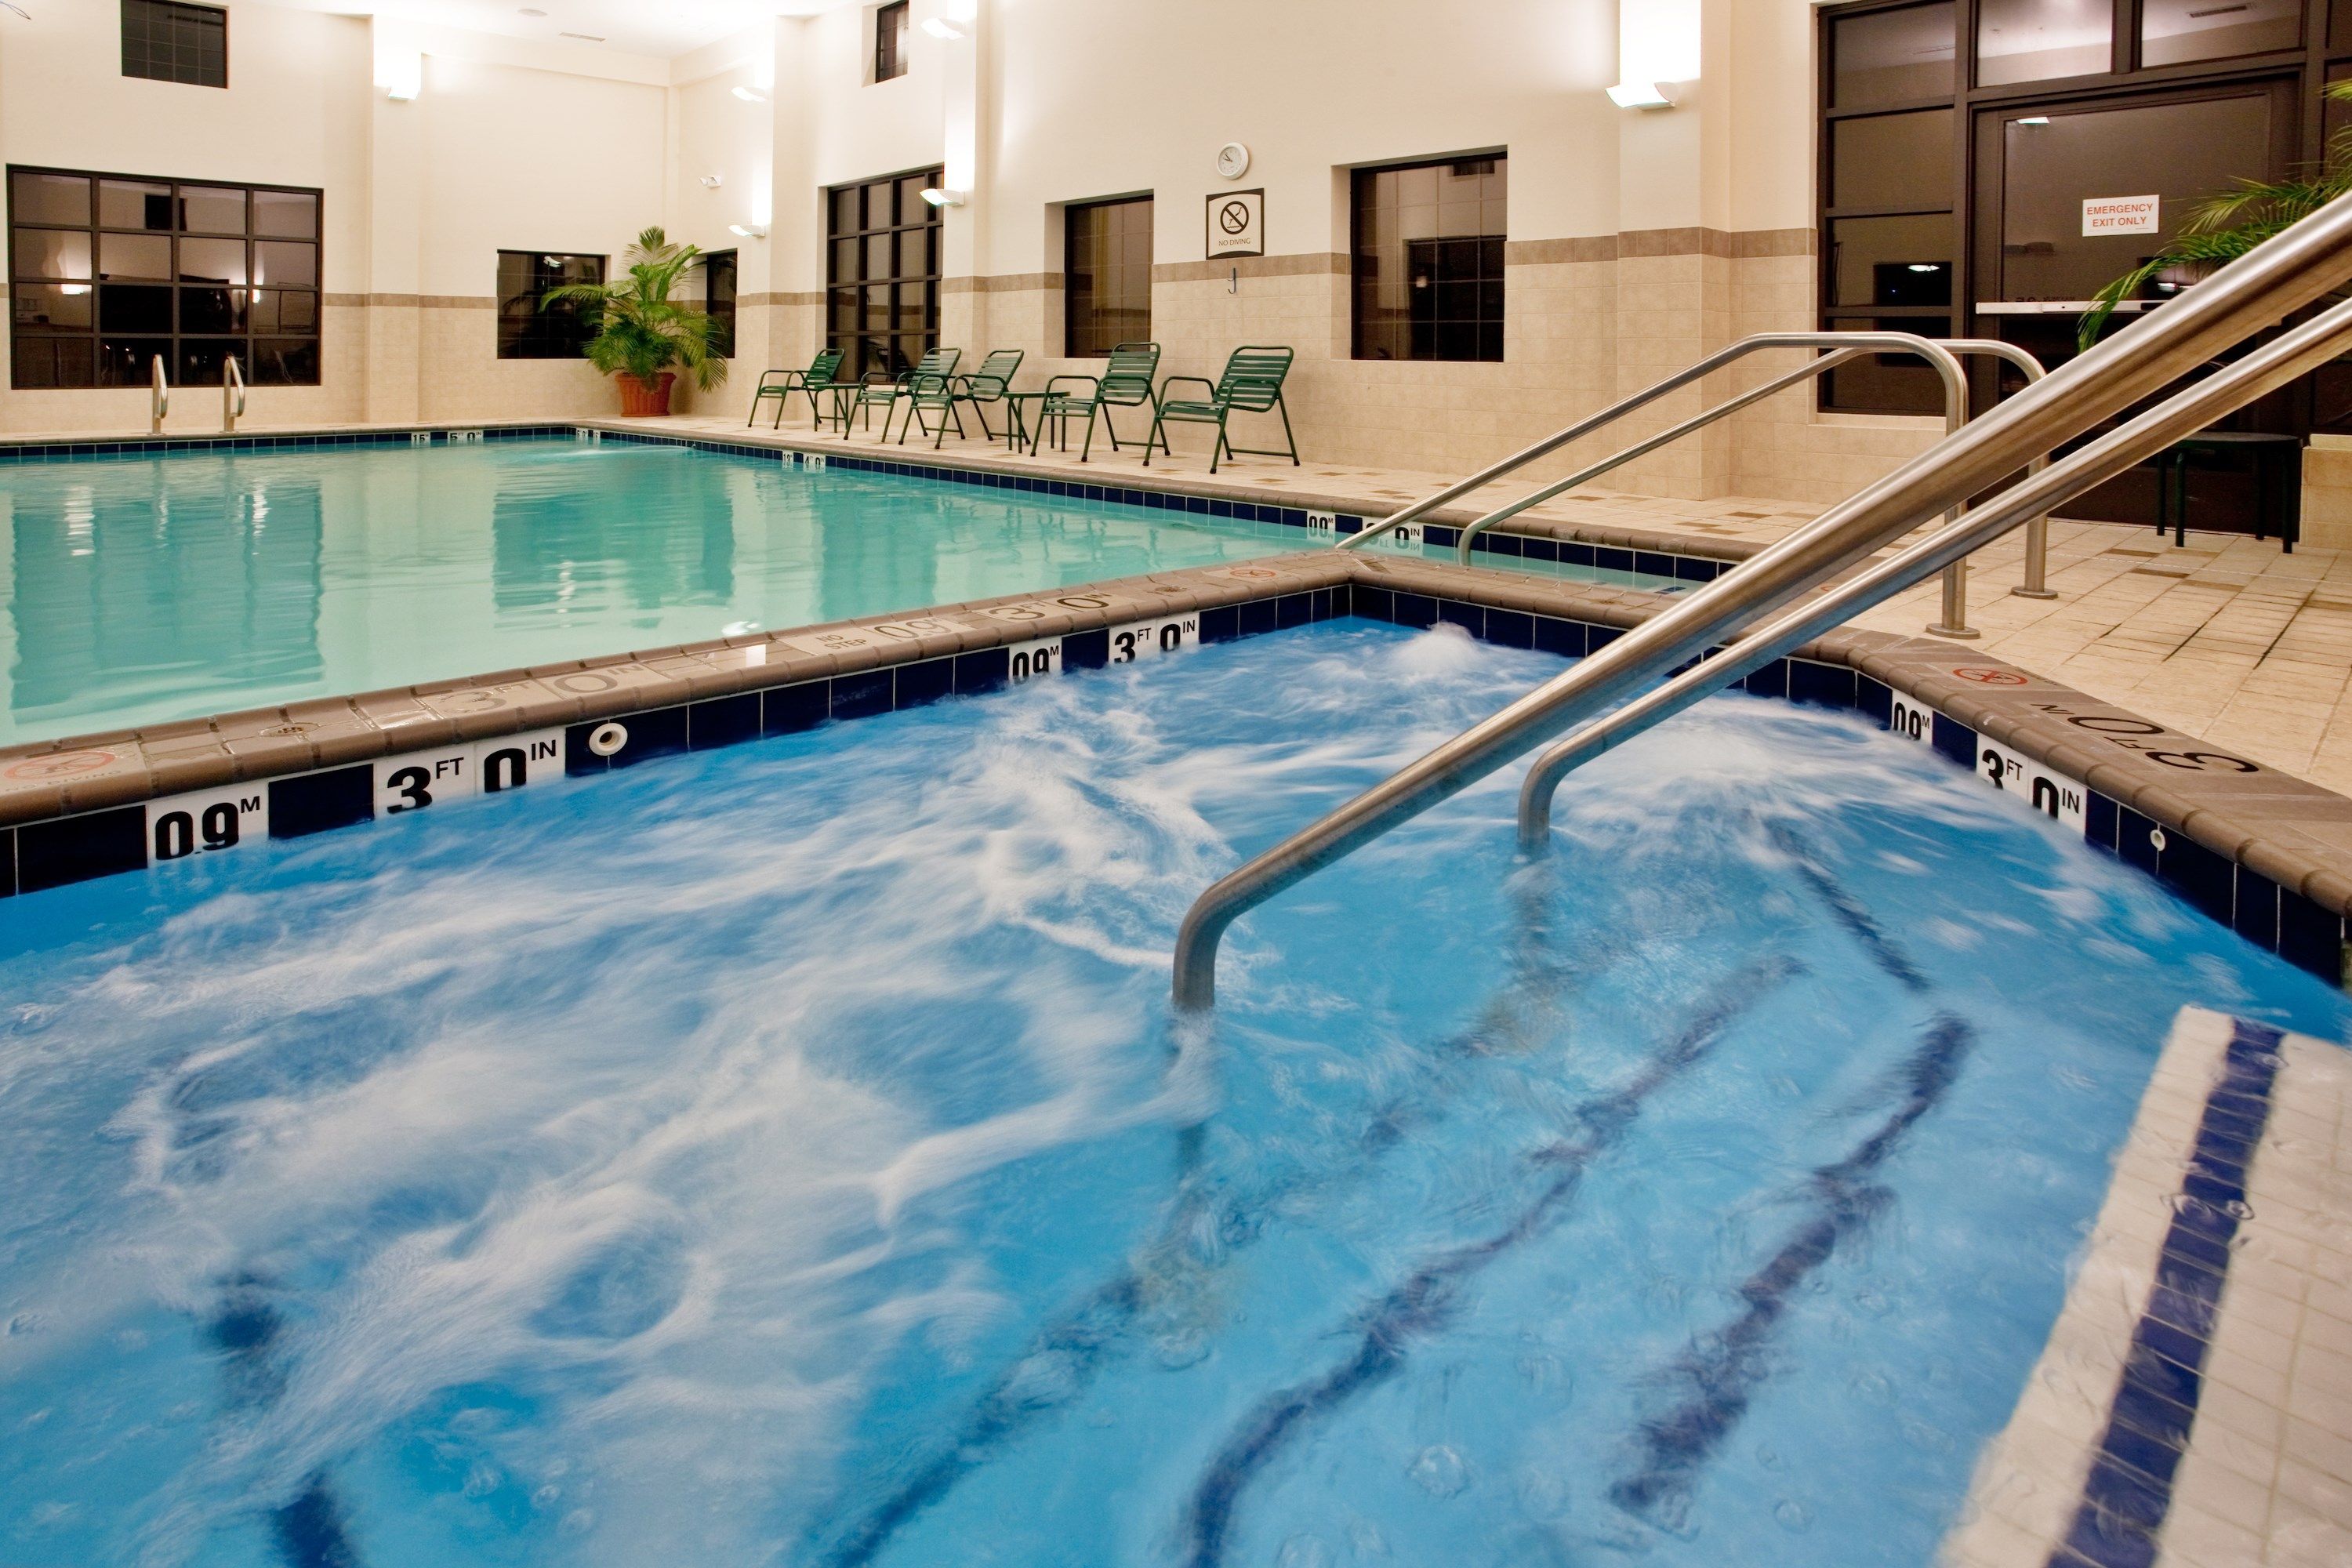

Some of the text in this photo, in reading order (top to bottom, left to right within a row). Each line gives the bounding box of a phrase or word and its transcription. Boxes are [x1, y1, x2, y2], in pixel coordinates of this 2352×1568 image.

[2086, 203, 2154, 215] EMERGENCY
[2092, 216, 2147, 227] EXIT ONLY
[816, 633, 844, 643] NO
[825, 638, 867, 650] STEP
